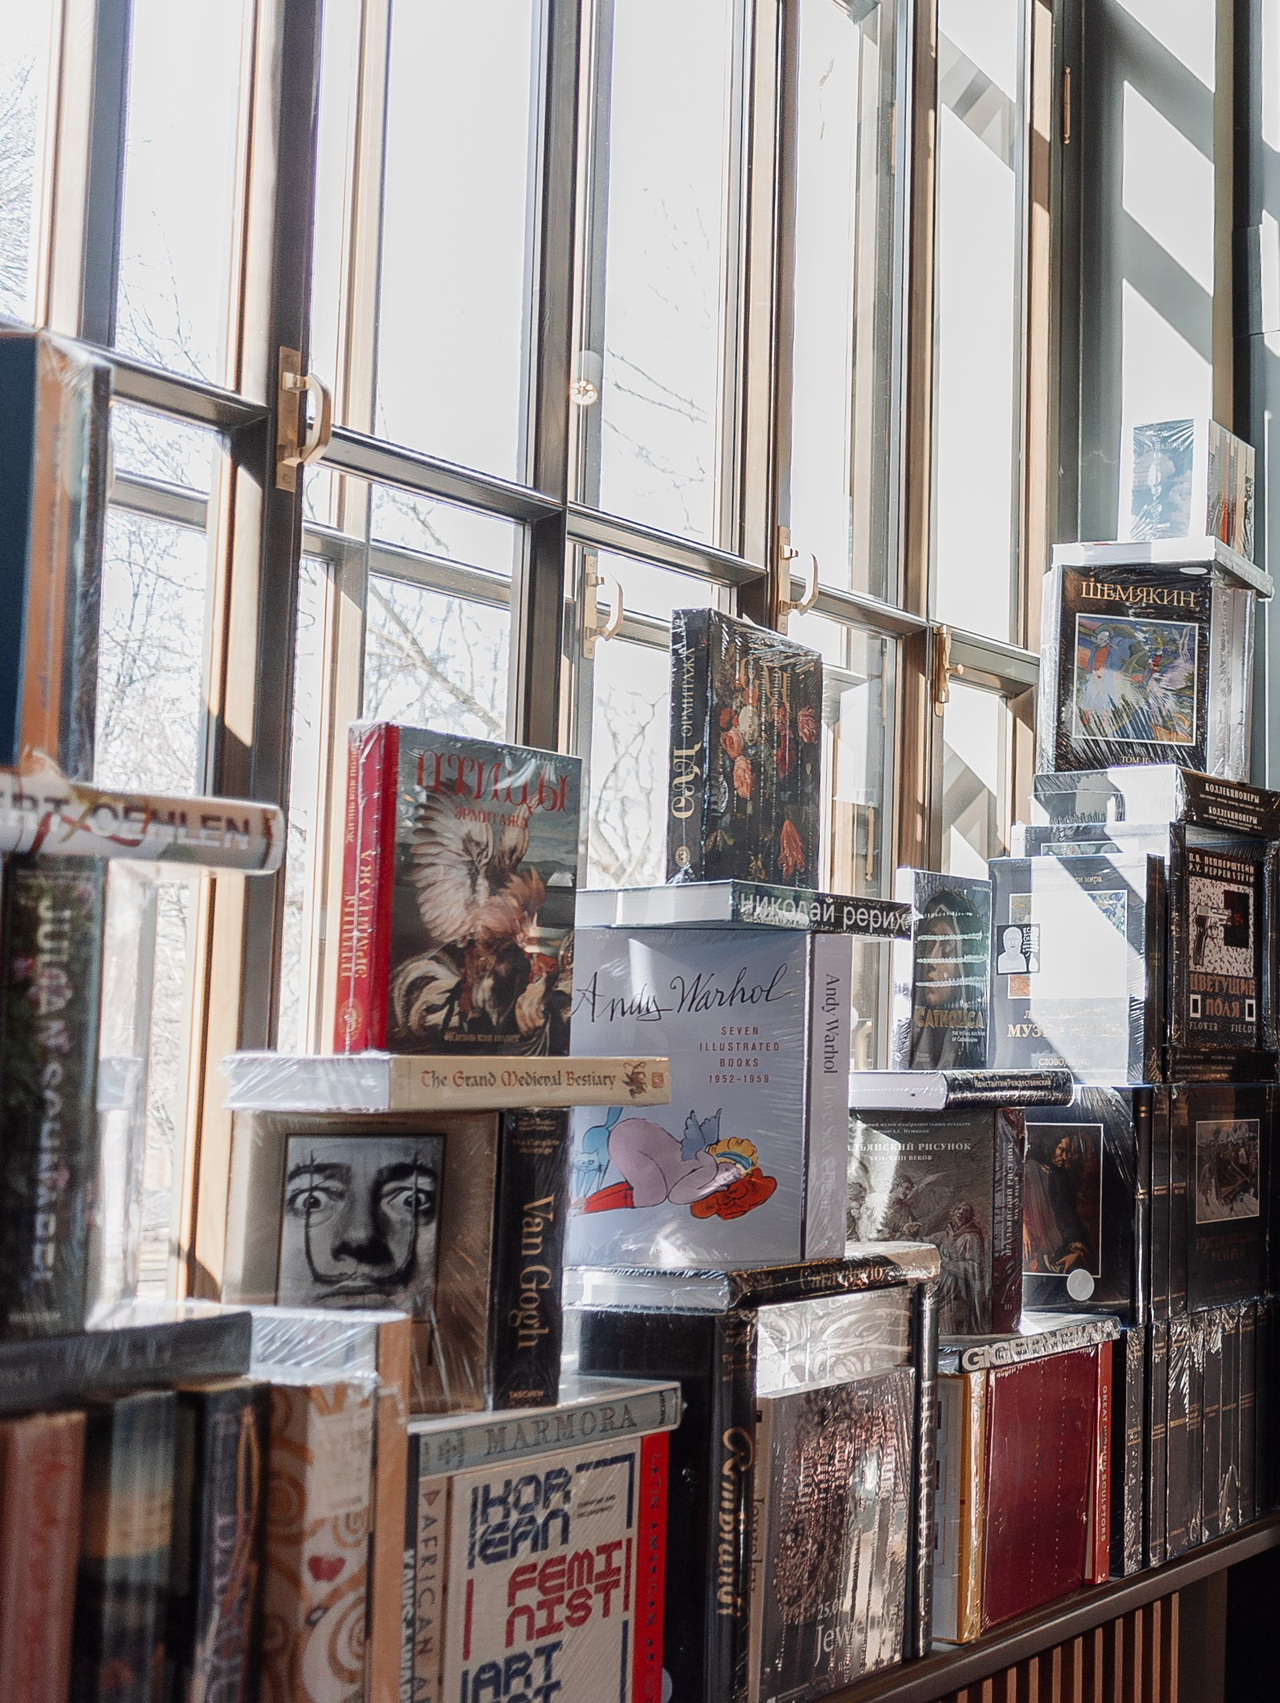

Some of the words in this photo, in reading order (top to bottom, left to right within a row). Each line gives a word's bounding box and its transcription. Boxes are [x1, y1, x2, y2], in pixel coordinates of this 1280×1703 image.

[1081, 580, 1197, 607] ШЕМЯКИН
[681, 647, 695, 737] ЭРМИТАЖА
[416, 749, 570, 816] ПТИЦЫ
[671, 742, 702, 819] САД
[1205, 783, 1260, 804] КОЛЛЕКЦИОНЕРЫ
[1208, 806, 1258, 824] КОЛЛЕКЦИОНЕРЫ
[1204, 866, 1255, 882] PEPPERSTEIN
[355, 850, 372, 979] ЭРМИТАЖА
[842, 905, 907, 933] рерих
[571, 971, 673, 1023] Andy
[669, 963, 795, 1013] Warhol
[822, 973, 840, 1013] Andy
[1189, 973, 1255, 996] ЦВЕТУЩИЕ
[916, 1010, 985, 1029] CATHOLICA
[1205, 998, 1240, 1018] ПОЛЯ
[1231, 1023, 1256, 1034] FIELDS
[699, 1041, 780, 1052] ILLUSTRATED
[720, 1026, 760, 1036] SEVEN
[824, 1018, 840, 1075] Warhol
[421, 1070, 448, 1088] The
[452, 1070, 497, 1088] Grand
[501, 1069, 561, 1088] Medieval
[565, 1070, 616, 1091] Bestiary
[708, 1074, 770, 1084] 1952-1959
[719, 1058, 760, 1068] BOOKS
[918, 1142, 971, 1151] РИСУНОК
[1004, 1141, 1014, 1185] РИСУНОК
[520, 1193, 555, 1256] Van
[800, 1264, 885, 1289] Caravaggio
[510, 1264, 552, 1349] Gogh
[486, 1404, 637, 1456] MARMORA
[482, 1466, 572, 1525] KOR
[649, 1453, 662, 1510] LATIN
[477, 1507, 571, 1566] EAN
[417, 1514, 438, 1656] AFRICAN
[507, 1540, 623, 1608] FEMI
[646, 1521, 659, 1627] AMERICAN
[505, 1578, 622, 1648] NIST
[472, 1640, 563, 1703] ART
